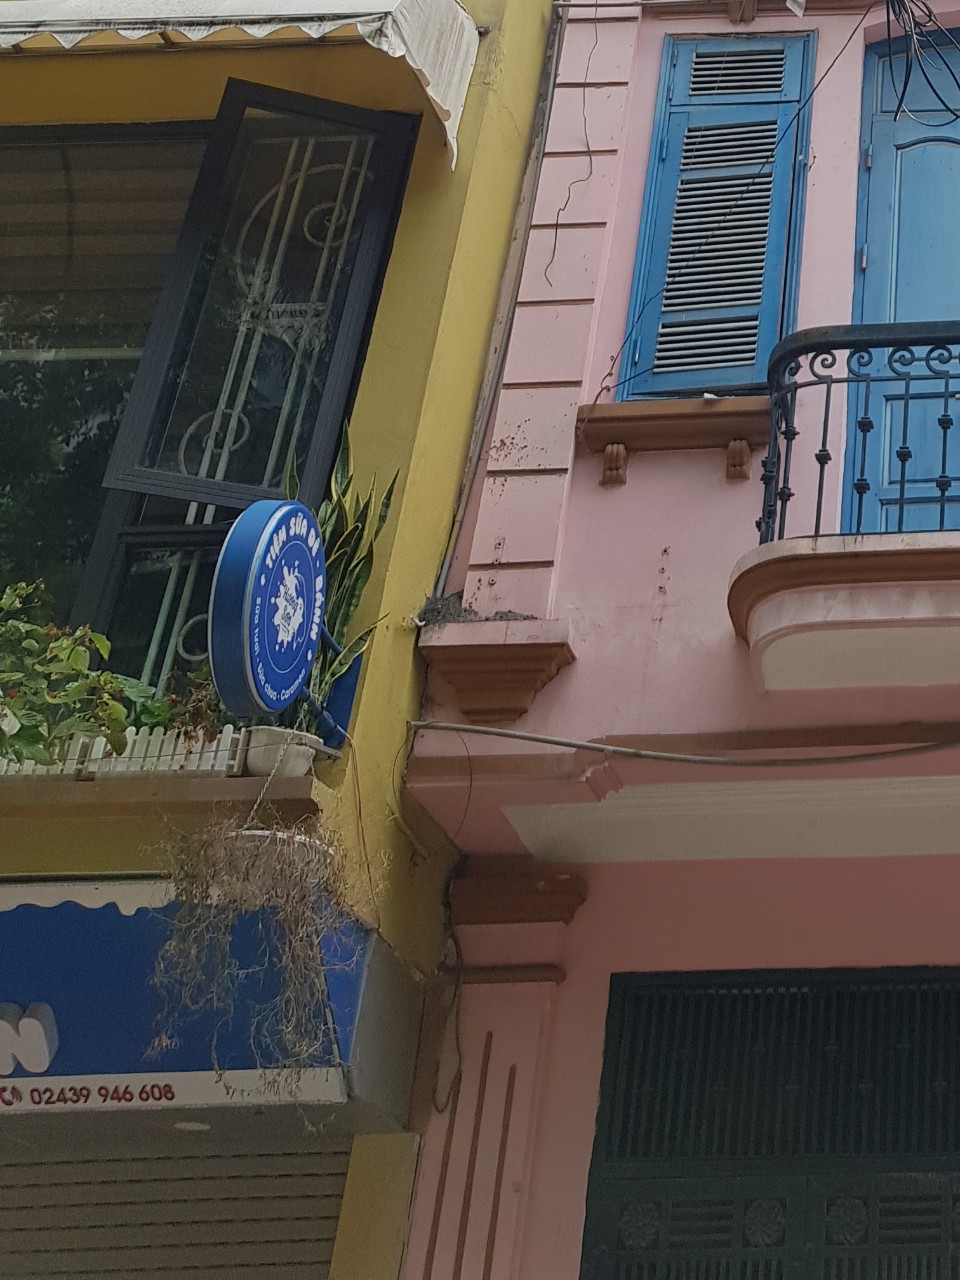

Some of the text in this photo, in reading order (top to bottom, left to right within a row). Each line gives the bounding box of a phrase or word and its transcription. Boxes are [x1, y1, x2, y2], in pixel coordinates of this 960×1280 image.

[30, 1083, 175, 1105] 02439 946 608
